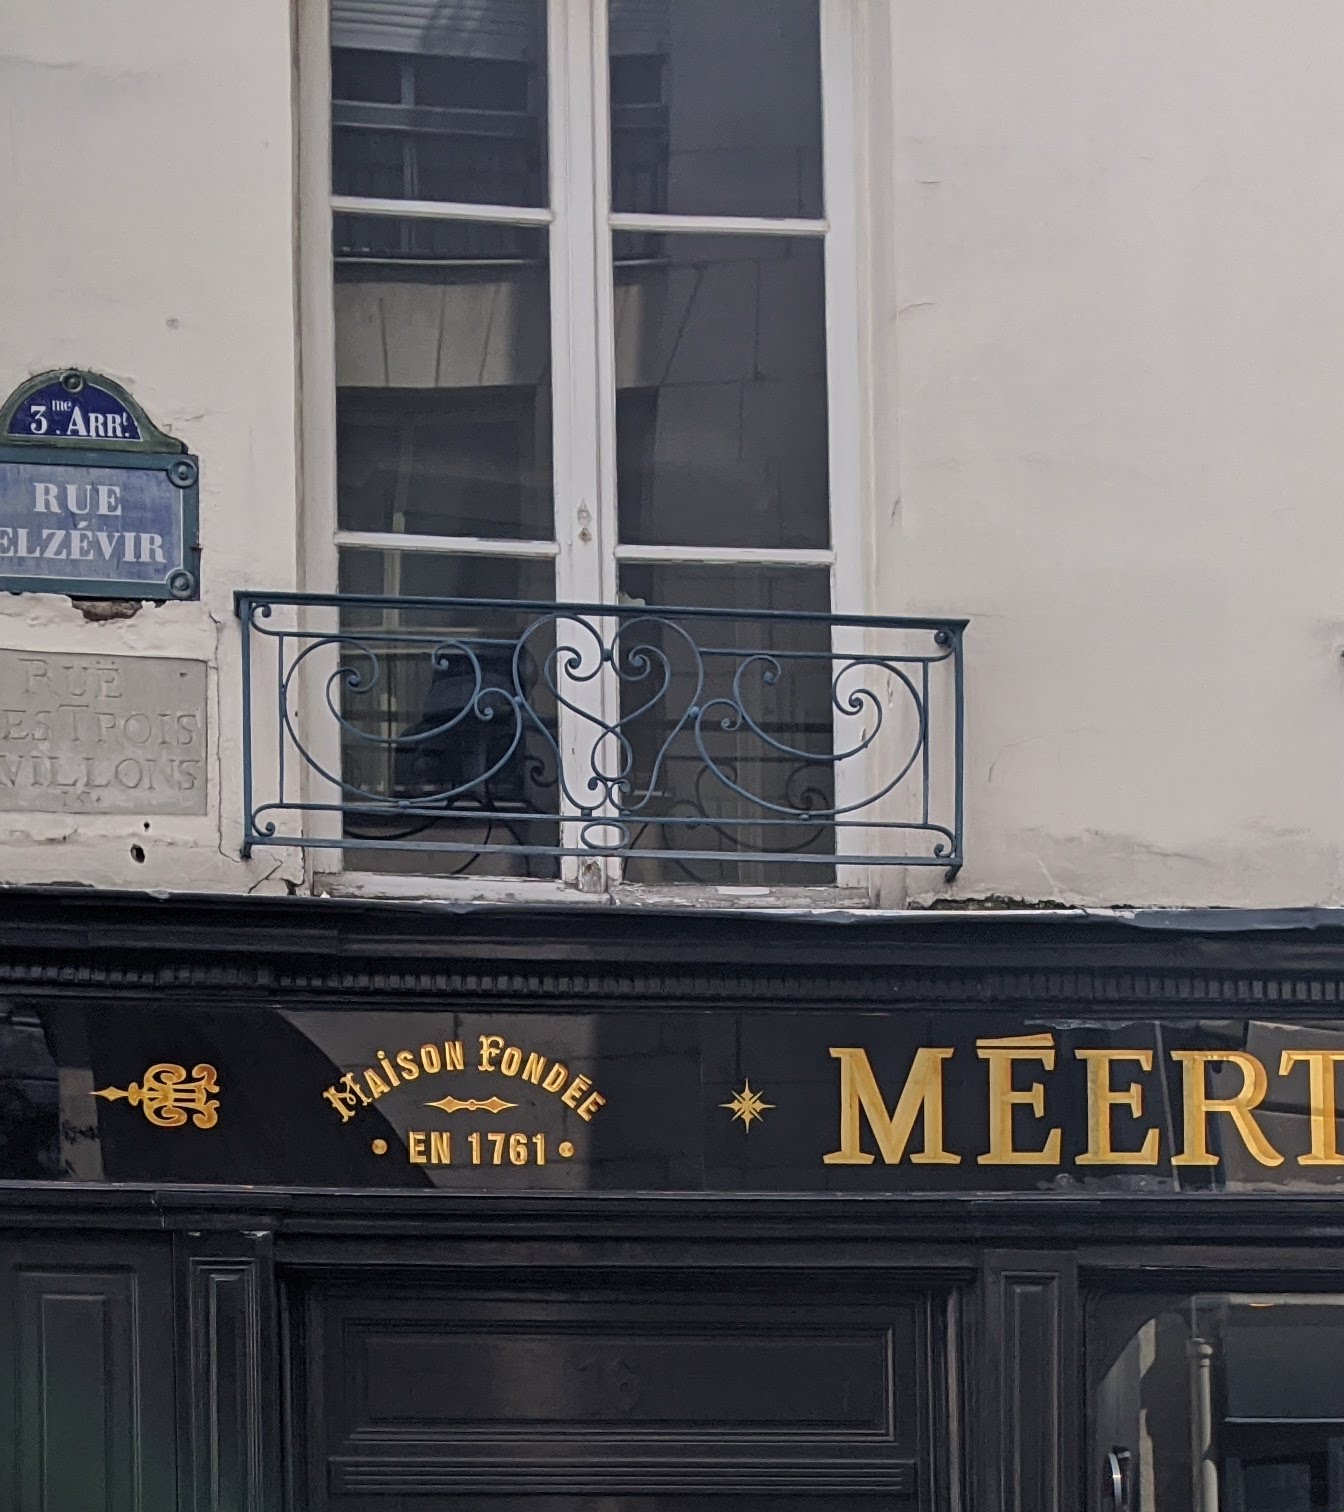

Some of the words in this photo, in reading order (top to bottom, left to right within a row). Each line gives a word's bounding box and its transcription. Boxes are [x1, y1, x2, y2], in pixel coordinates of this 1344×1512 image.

[32, 482, 123, 516] RUE
[408, 1131, 451, 1165] EN
[467, 1132, 546, 1166] 1761
